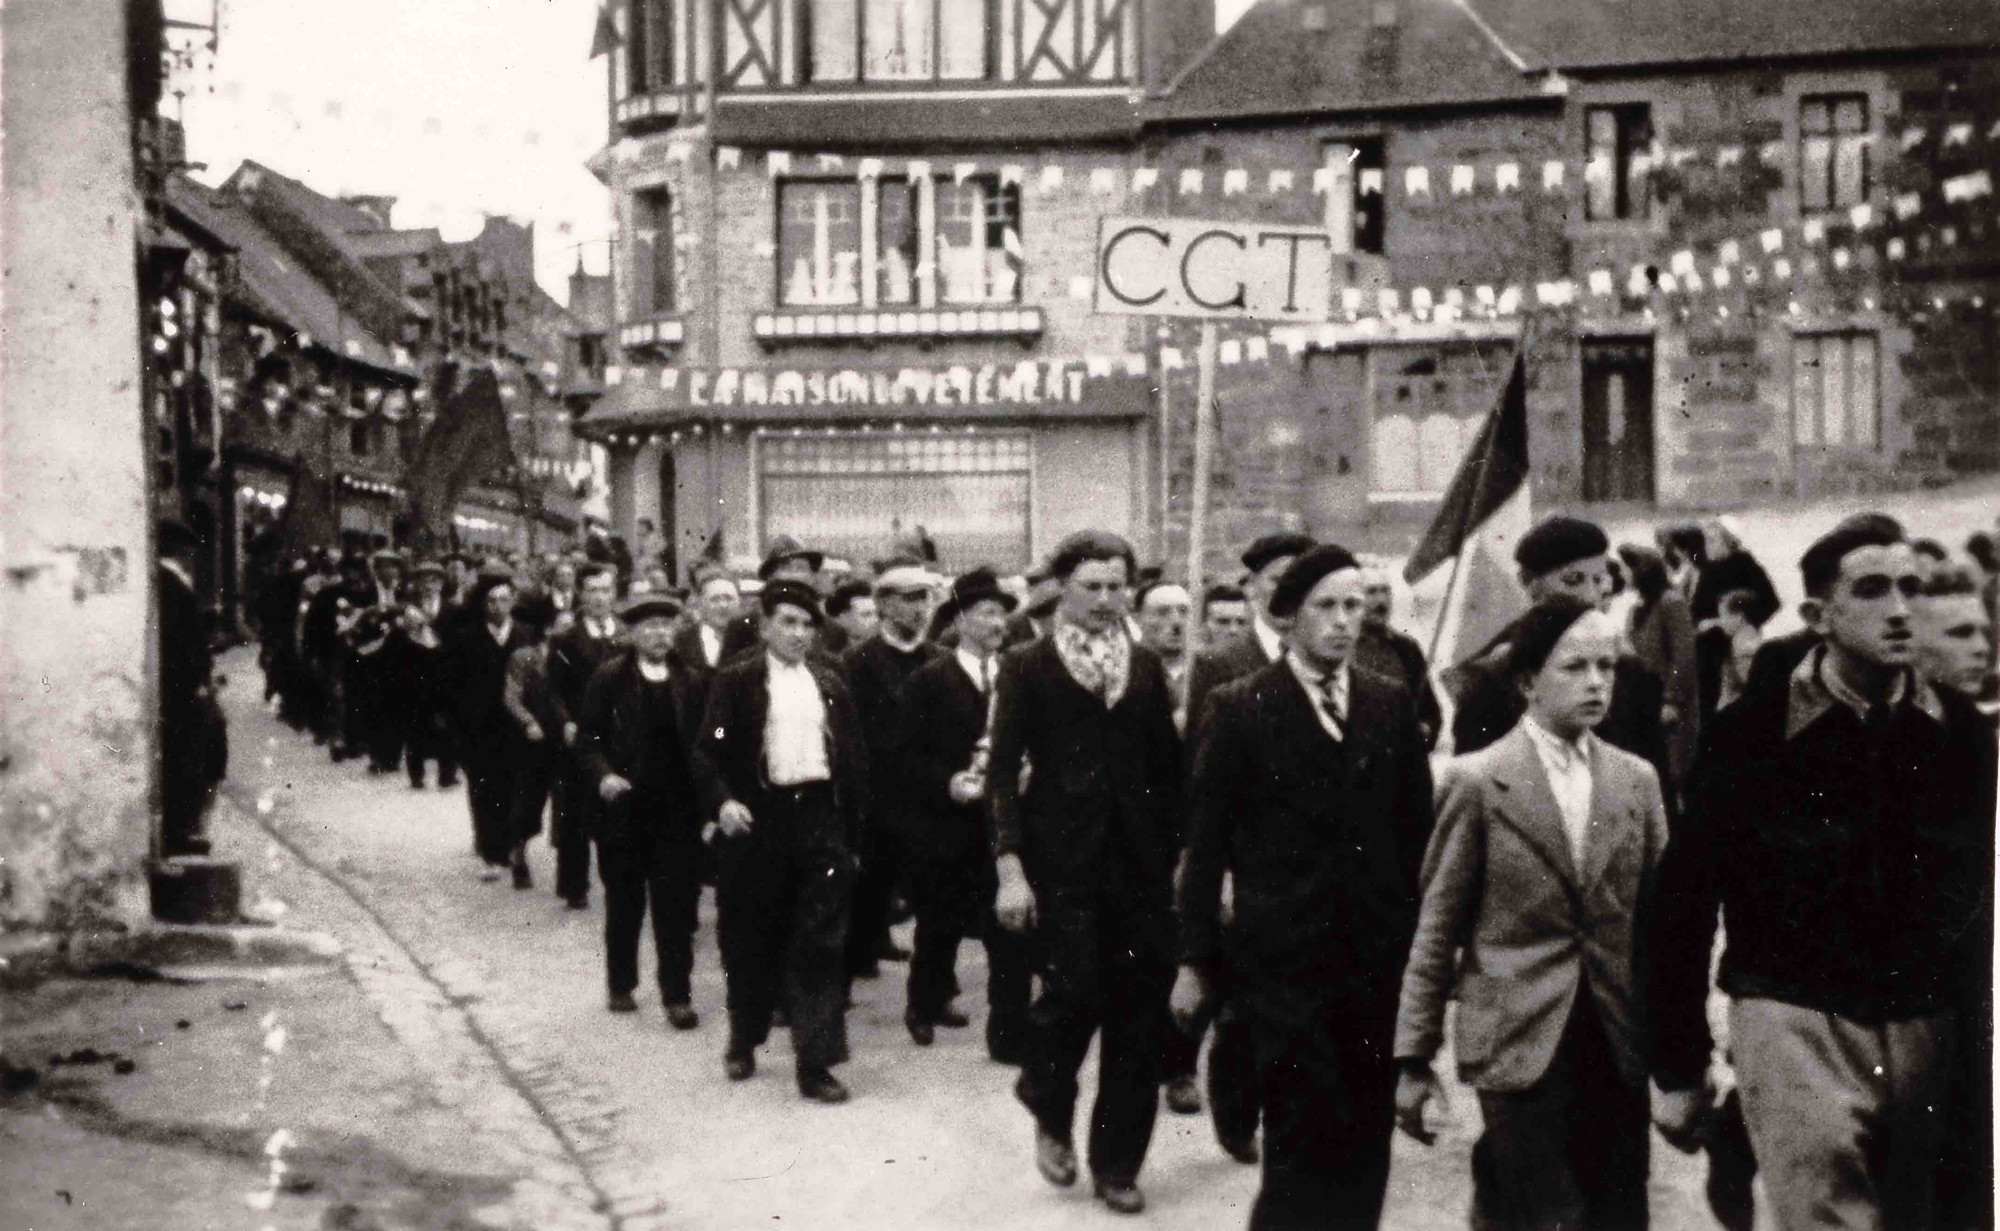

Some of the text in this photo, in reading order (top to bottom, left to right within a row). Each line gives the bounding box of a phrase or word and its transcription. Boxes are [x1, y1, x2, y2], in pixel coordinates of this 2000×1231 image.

[1102, 225, 1332, 312] CGT
[690, 370, 739, 405] LA
[743, 370, 869, 405] MAISON
